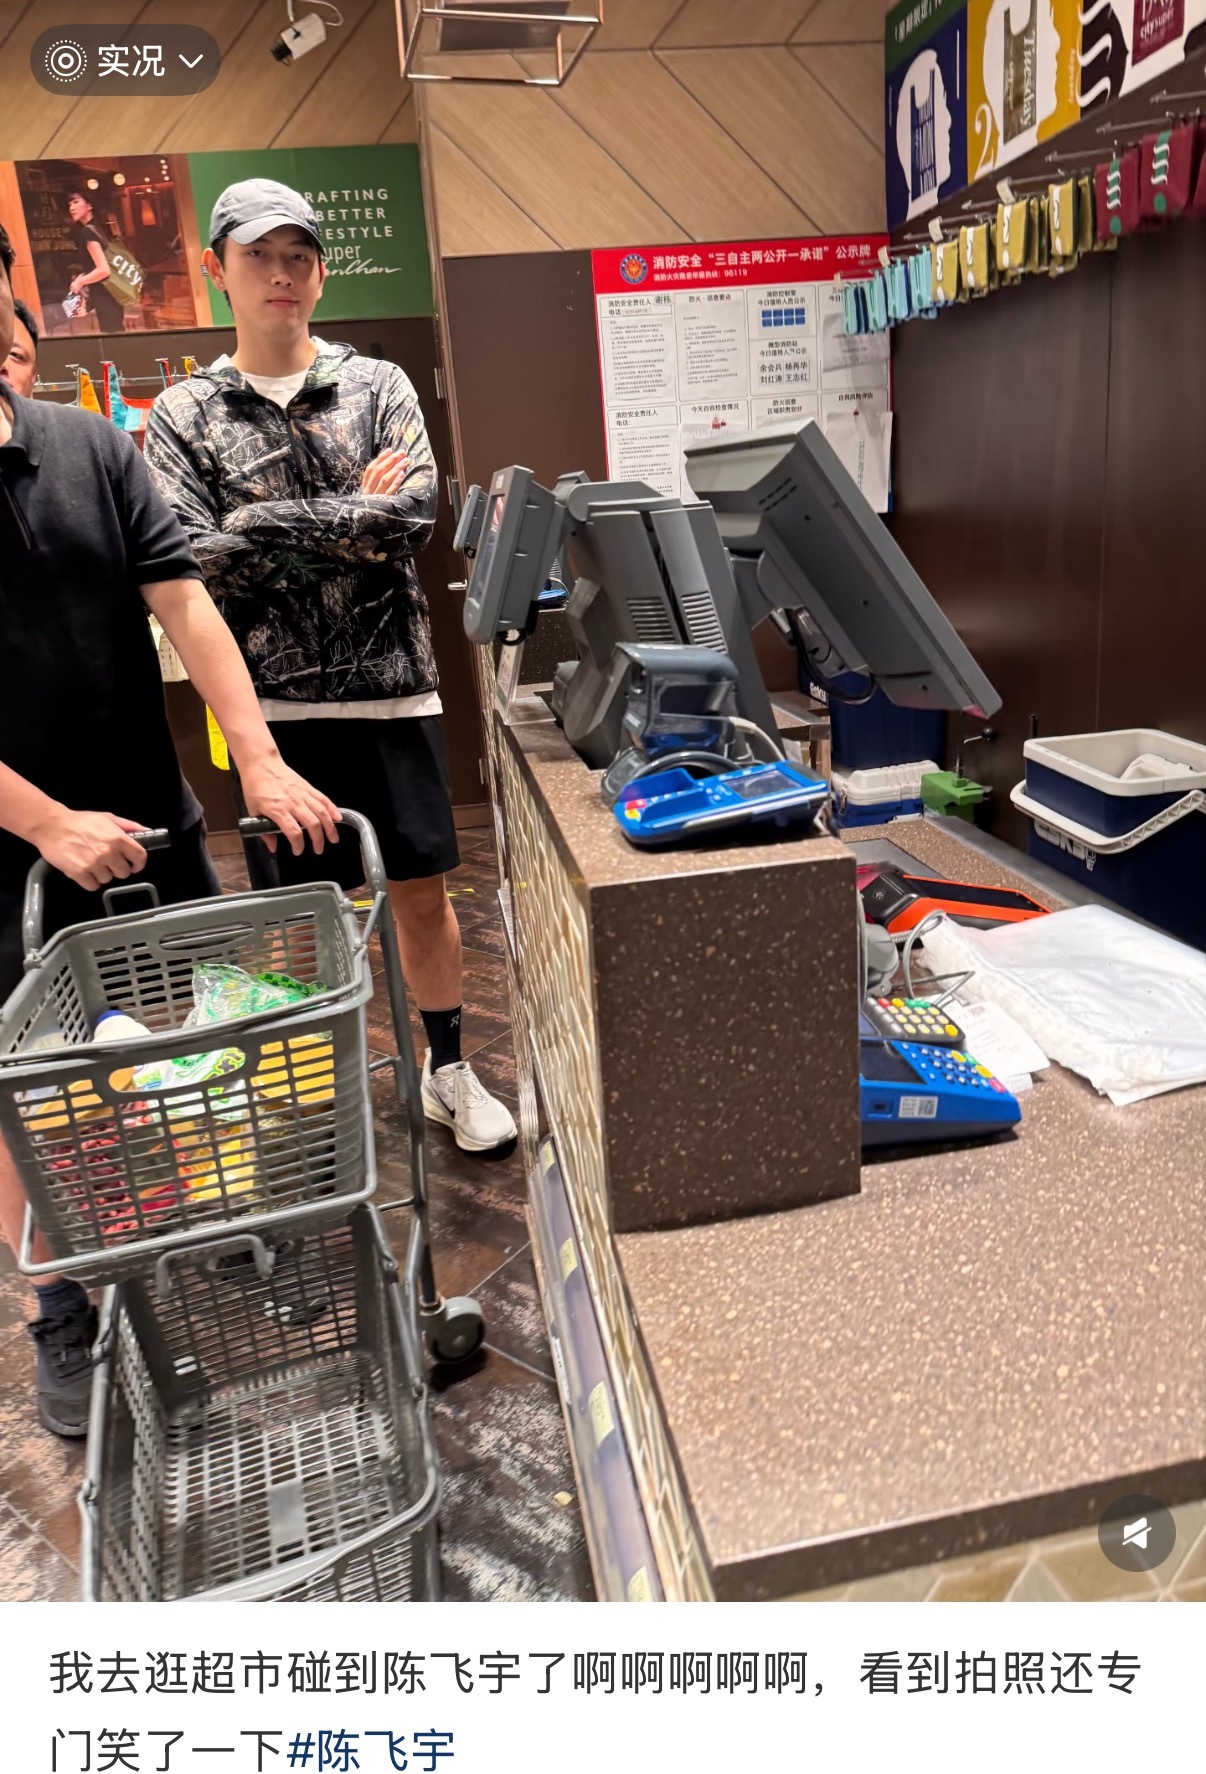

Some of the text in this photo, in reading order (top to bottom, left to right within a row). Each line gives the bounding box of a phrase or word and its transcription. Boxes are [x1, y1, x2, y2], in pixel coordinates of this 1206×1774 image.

[304, 188, 389, 203] RAFTING
[315, 207, 386, 222] BETTER
[319, 225, 394, 240] ESTYLE
[321, 245, 361, 264] uper
